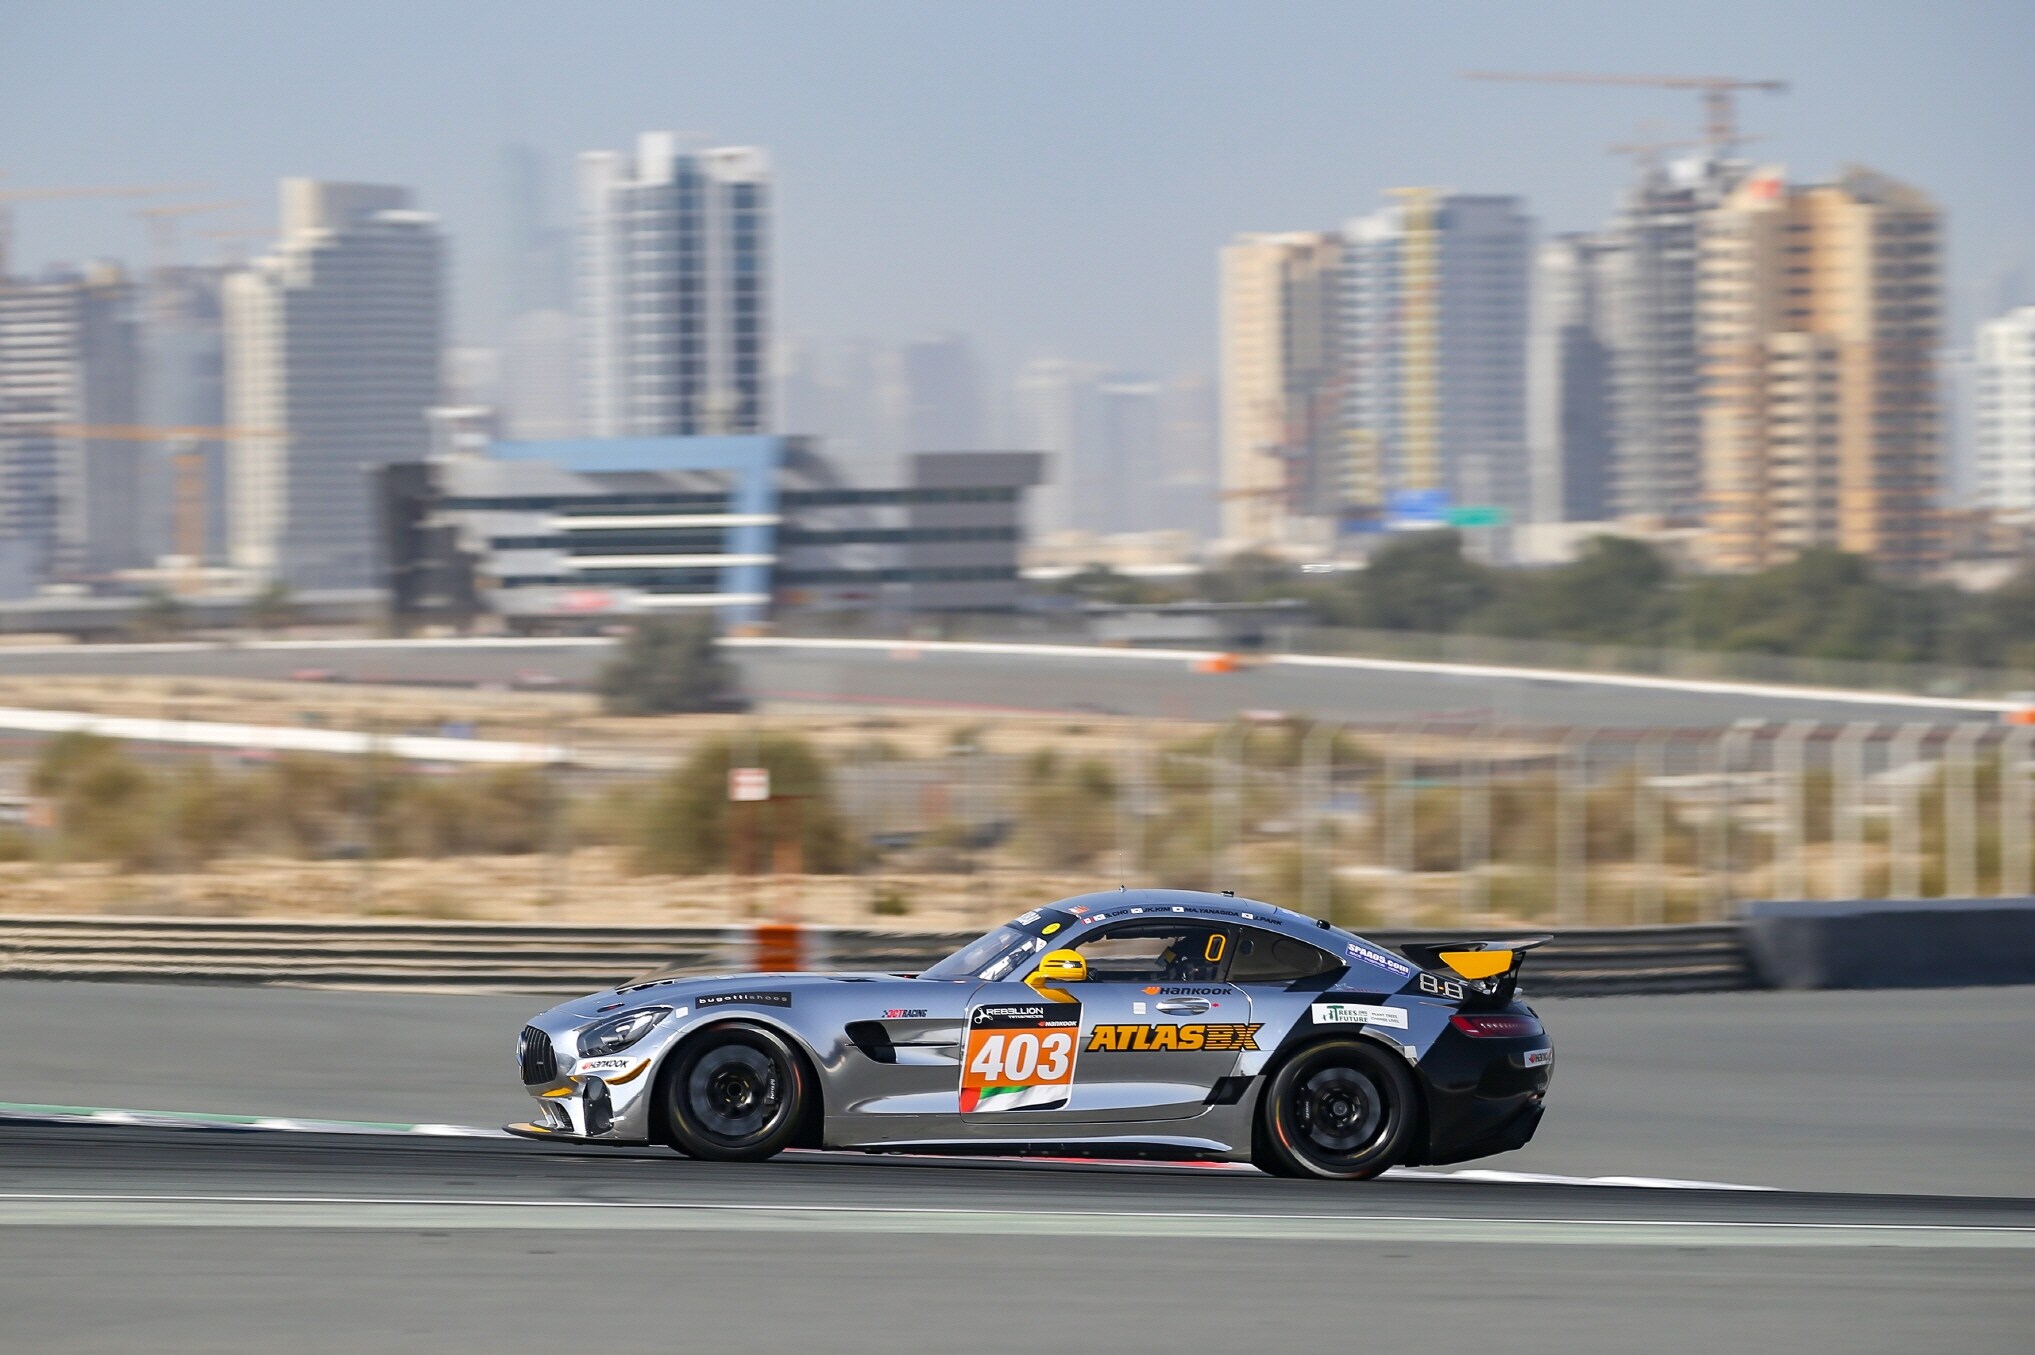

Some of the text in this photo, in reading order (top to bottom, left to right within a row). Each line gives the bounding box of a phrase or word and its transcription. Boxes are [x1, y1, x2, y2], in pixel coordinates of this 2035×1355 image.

[1340, 1015, 1368, 1023] FUTURE
[1087, 1024, 1263, 1051] ATLASBX
[970, 1033, 1072, 1080] 403
